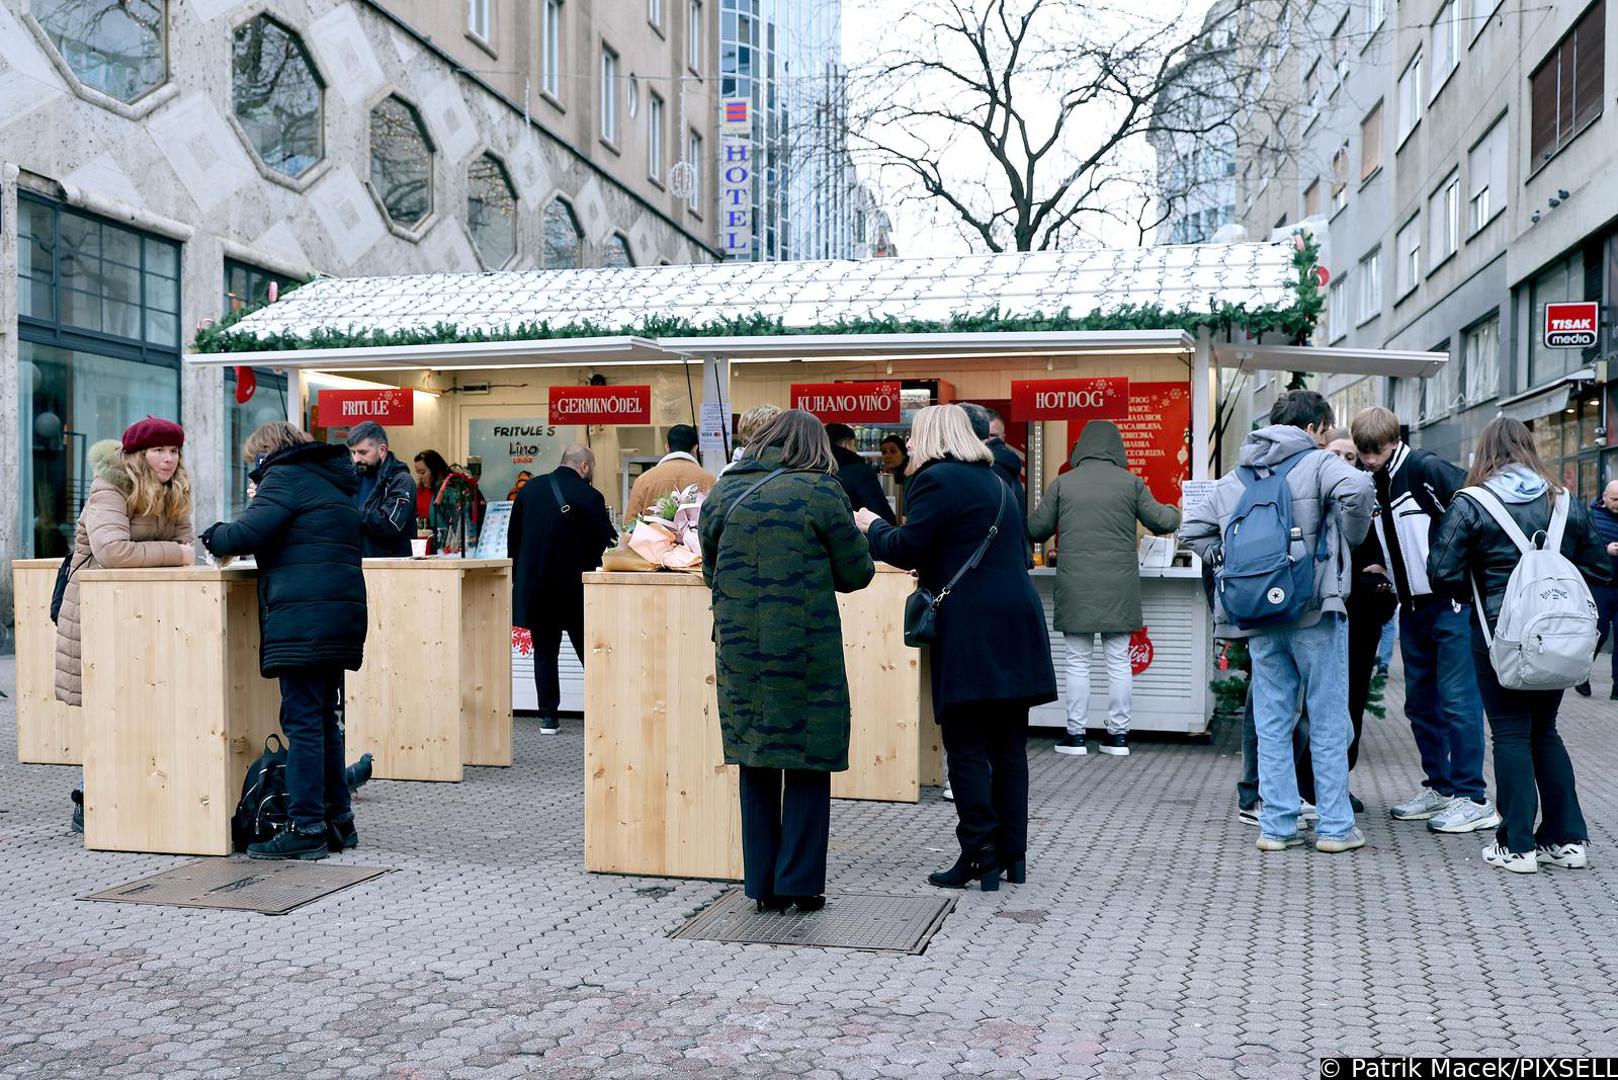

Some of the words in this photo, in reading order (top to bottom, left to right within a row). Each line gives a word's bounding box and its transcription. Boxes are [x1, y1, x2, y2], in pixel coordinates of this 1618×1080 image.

[725, 145, 748, 249] HOTEL
[1551, 319, 1592, 330] TISAK
[1552, 333, 1591, 344] media
[557, 395, 642, 414] GERMKNÖDEL
[797, 395, 857, 412] KUHANO
[859, 395, 891, 411] VINO
[1035, 391, 1065, 409] HOT
[1068, 390, 1104, 408] DOG
[342, 400, 389, 416] FRITULE
[493, 425, 543, 437] FRITULE
[546, 426, 556, 437] S
[509, 441, 540, 456] Lino
